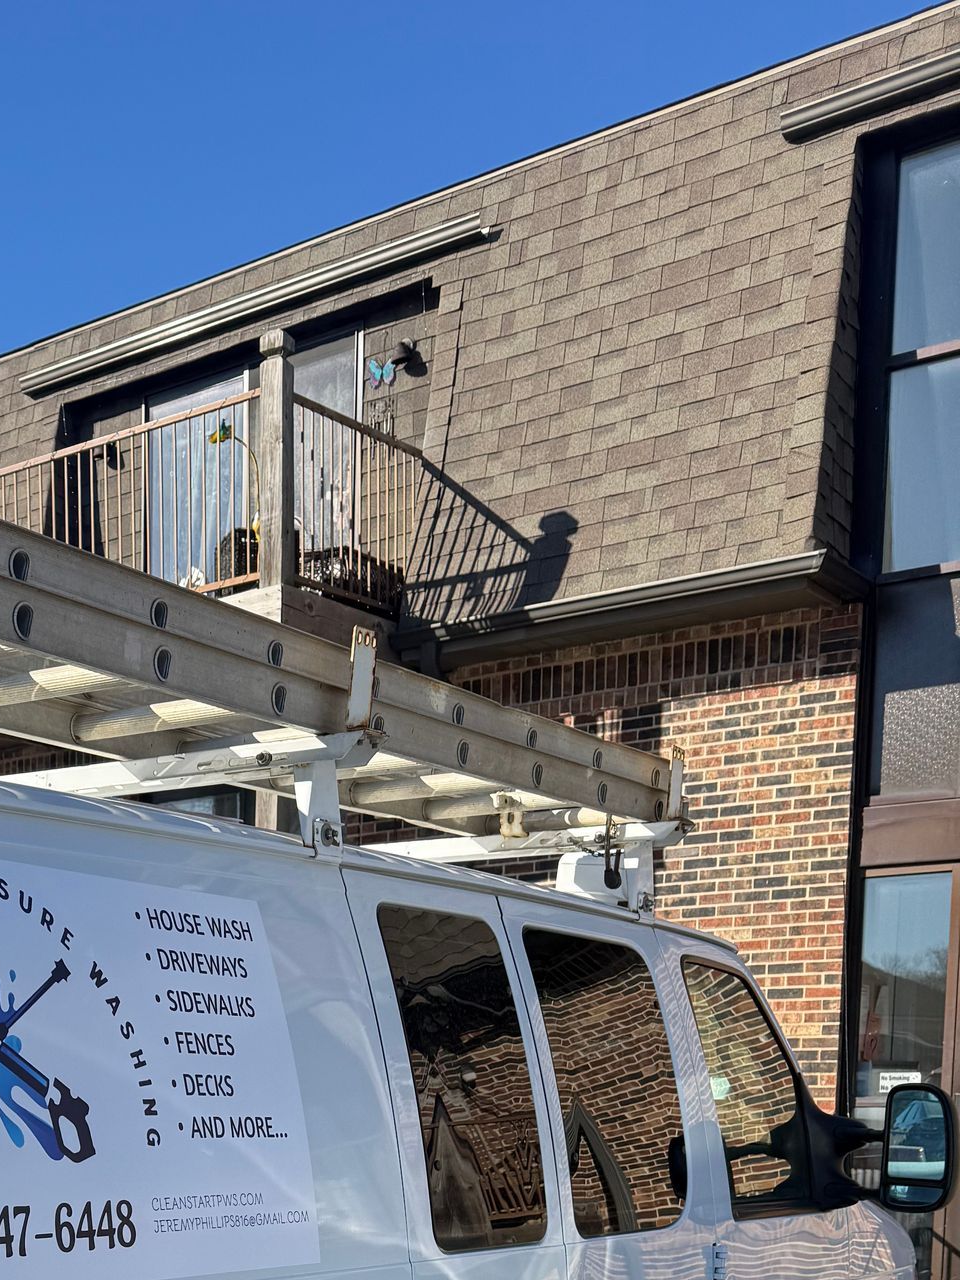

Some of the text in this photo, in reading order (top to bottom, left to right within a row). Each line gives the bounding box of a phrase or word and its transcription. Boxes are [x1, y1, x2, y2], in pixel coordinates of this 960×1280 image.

[146, 907, 253, 942] HOUSE WASH
[156, 948, 248, 978] DRIVEWAYS
[166, 989, 255, 1018] SIDEWALKS
[89, 962, 161, 1148] WASHING
[175, 1031, 235, 1056] FENCES
[183, 1073, 234, 1097] DECKS
[191, 1116, 288, 1139] AND MORE...
[151, 1192, 264, 1211] CLEANSTARTPWS.COM
[153, 1211, 310, 1233] JEREMYPHILLIPS816@GMAIL.COM
